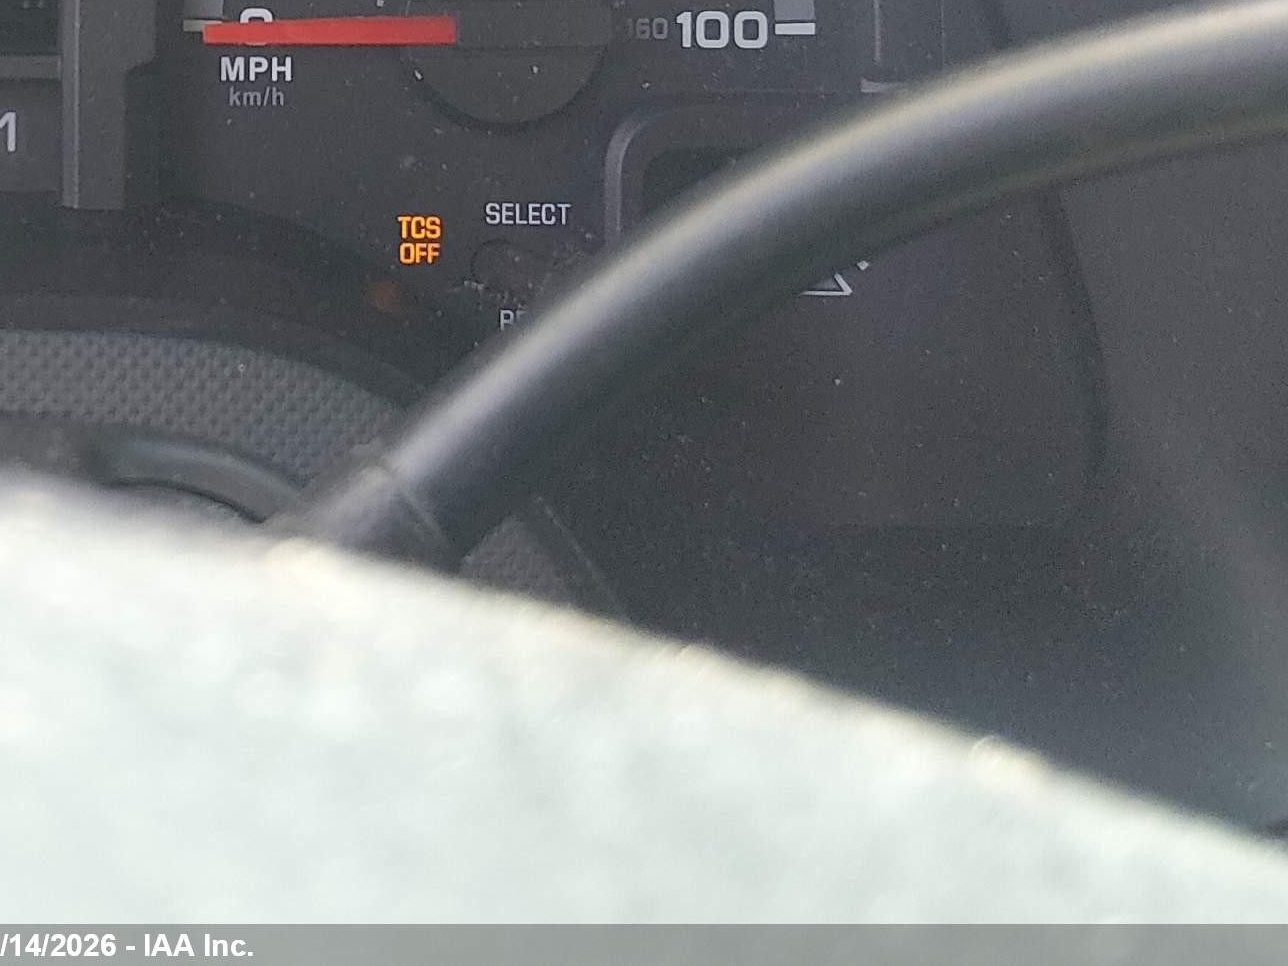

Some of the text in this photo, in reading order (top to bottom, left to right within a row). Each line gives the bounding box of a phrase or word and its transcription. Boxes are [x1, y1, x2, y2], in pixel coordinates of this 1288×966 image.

[625, 17, 668, 40] 160
[676, 10, 768, 49] 100
[220, 56, 293, 82] MPH
[229, 86, 285, 107] km/h
[485, 203, 571, 226] SELECT
[397, 215, 441, 240] TCS
[399, 243, 440, 265] OFF
